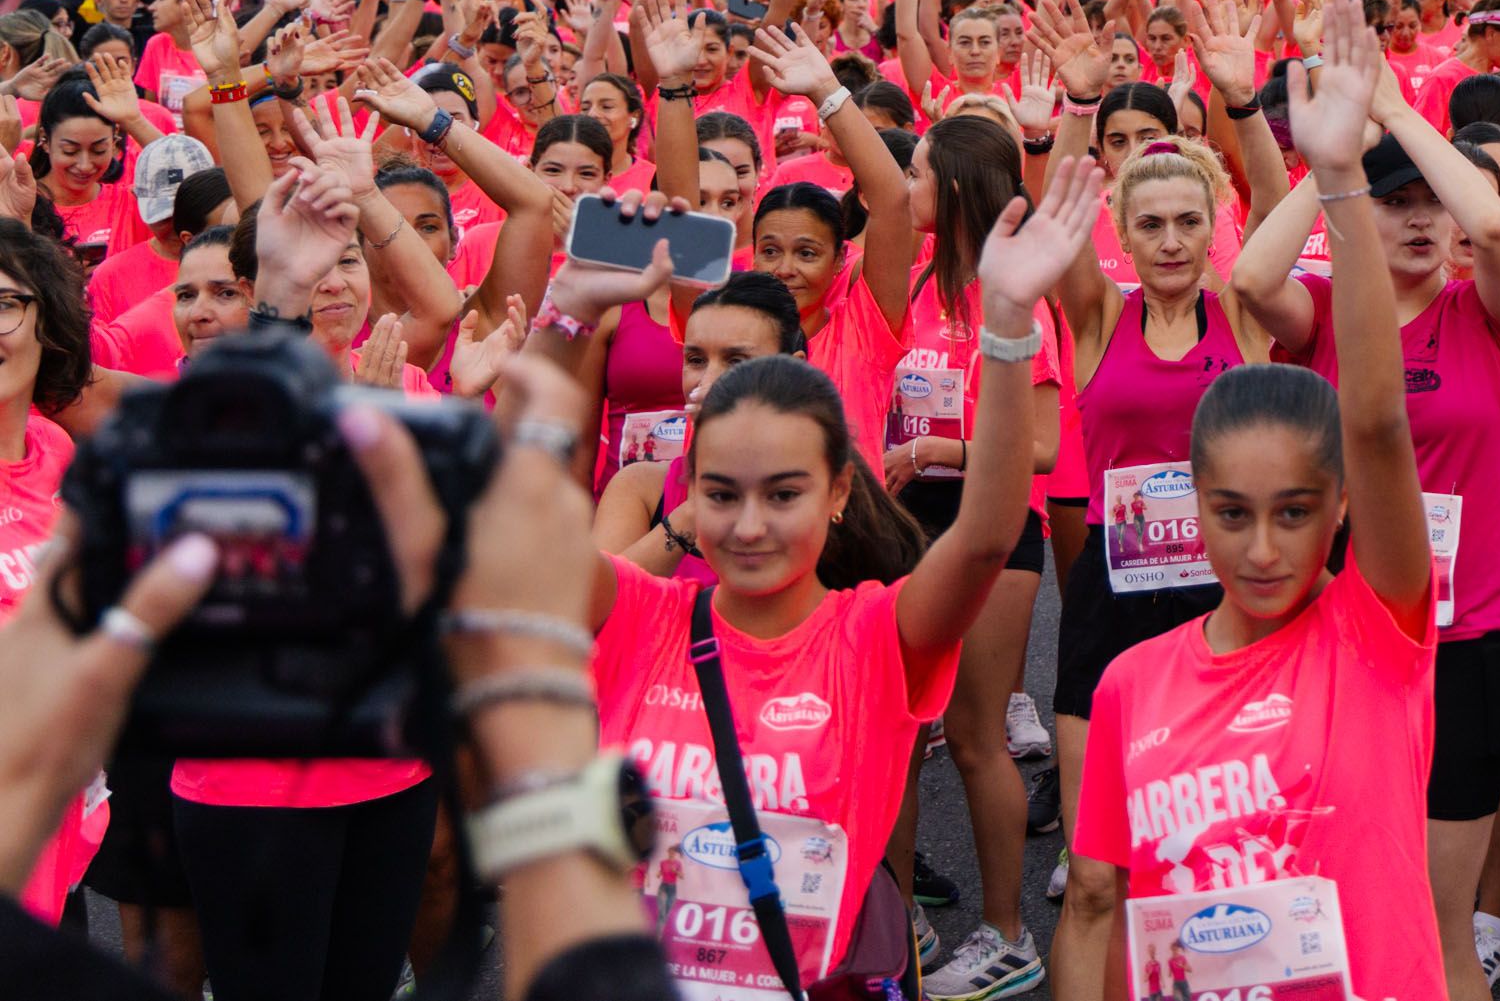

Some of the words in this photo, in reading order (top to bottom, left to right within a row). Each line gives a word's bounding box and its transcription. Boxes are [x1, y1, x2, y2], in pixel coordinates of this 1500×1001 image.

[903, 416, 930, 435] 016
[1114, 479, 1137, 489] SUMA
[1146, 481, 1195, 494] ASTURIAN
[1148, 519, 1199, 542] 016
[1166, 544, 1185, 554] 895
[1120, 558, 1149, 567] CARRERA
[1149, 556, 1159, 565] DE
[1160, 555, 1169, 564] LA
[1170, 554, 1192, 563] MUJER
[1125, 571, 1165, 583] OYSHO
[645, 684, 705, 712] OYSH
[1127, 754, 1280, 848] ARRERA
[676, 903, 759, 944] 016
[1144, 919, 1174, 933] SUMA
[1187, 922, 1265, 945] ASTURIANA
[695, 947, 727, 964] 867
[682, 964, 699, 978] LA
[700, 967, 736, 983] MUJER
